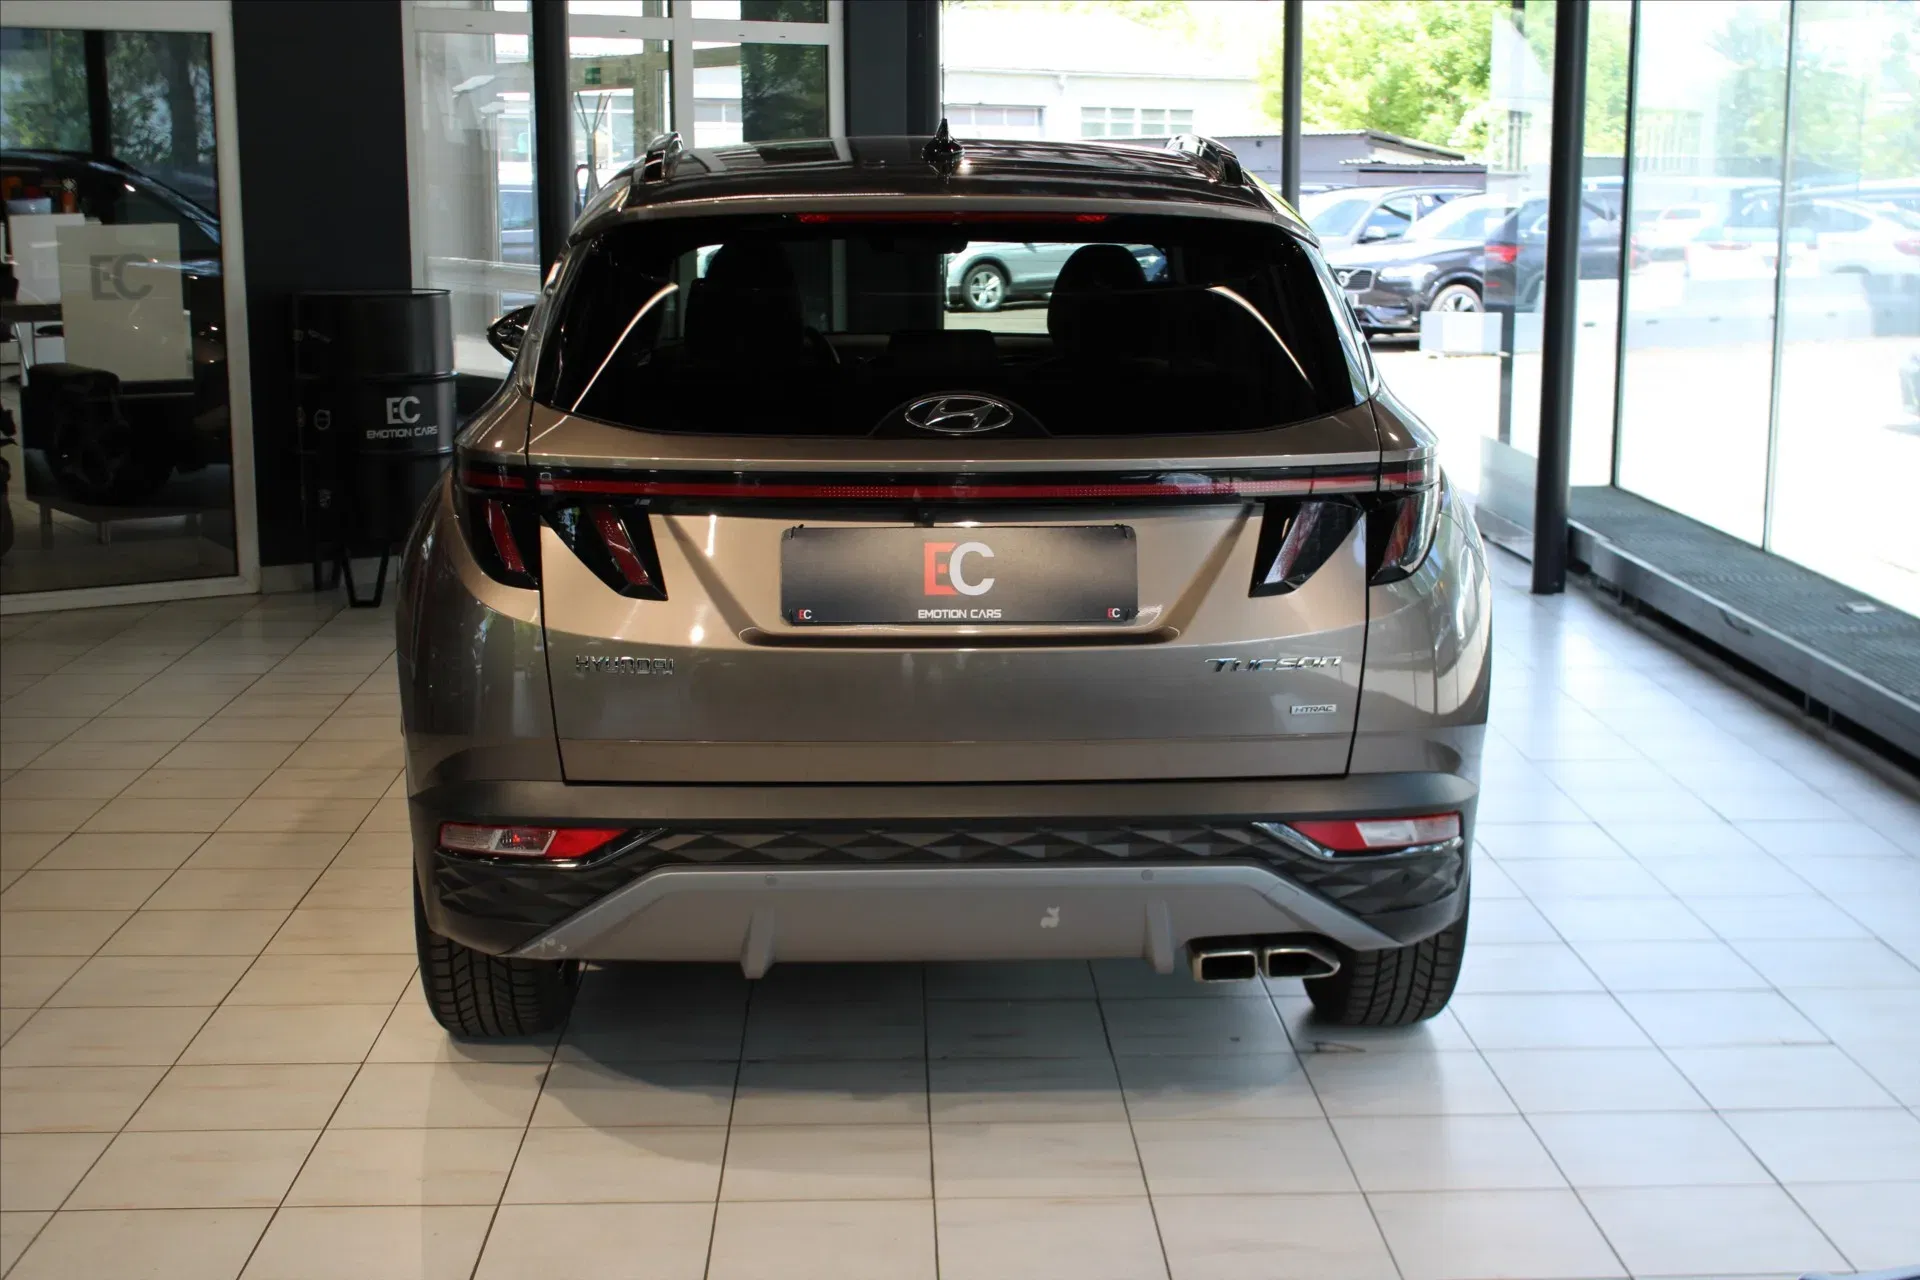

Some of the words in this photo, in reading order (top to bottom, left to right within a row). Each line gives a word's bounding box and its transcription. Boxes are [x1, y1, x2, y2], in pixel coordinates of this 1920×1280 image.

[90, 253, 153, 300] EC
[386, 396, 421, 424] EC
[366, 429, 412, 439] EMOTION
[414, 425, 438, 436] CARS
[924, 541, 995, 596] EC
[799, 609, 812, 620] EC
[917, 609, 967, 619] EMOTION
[970, 609, 1002, 618] CARS
[1107, 607, 1121, 618] EC
[575, 654, 674, 675] HYUNDAI
[1294, 705, 1334, 714] HTRAC
